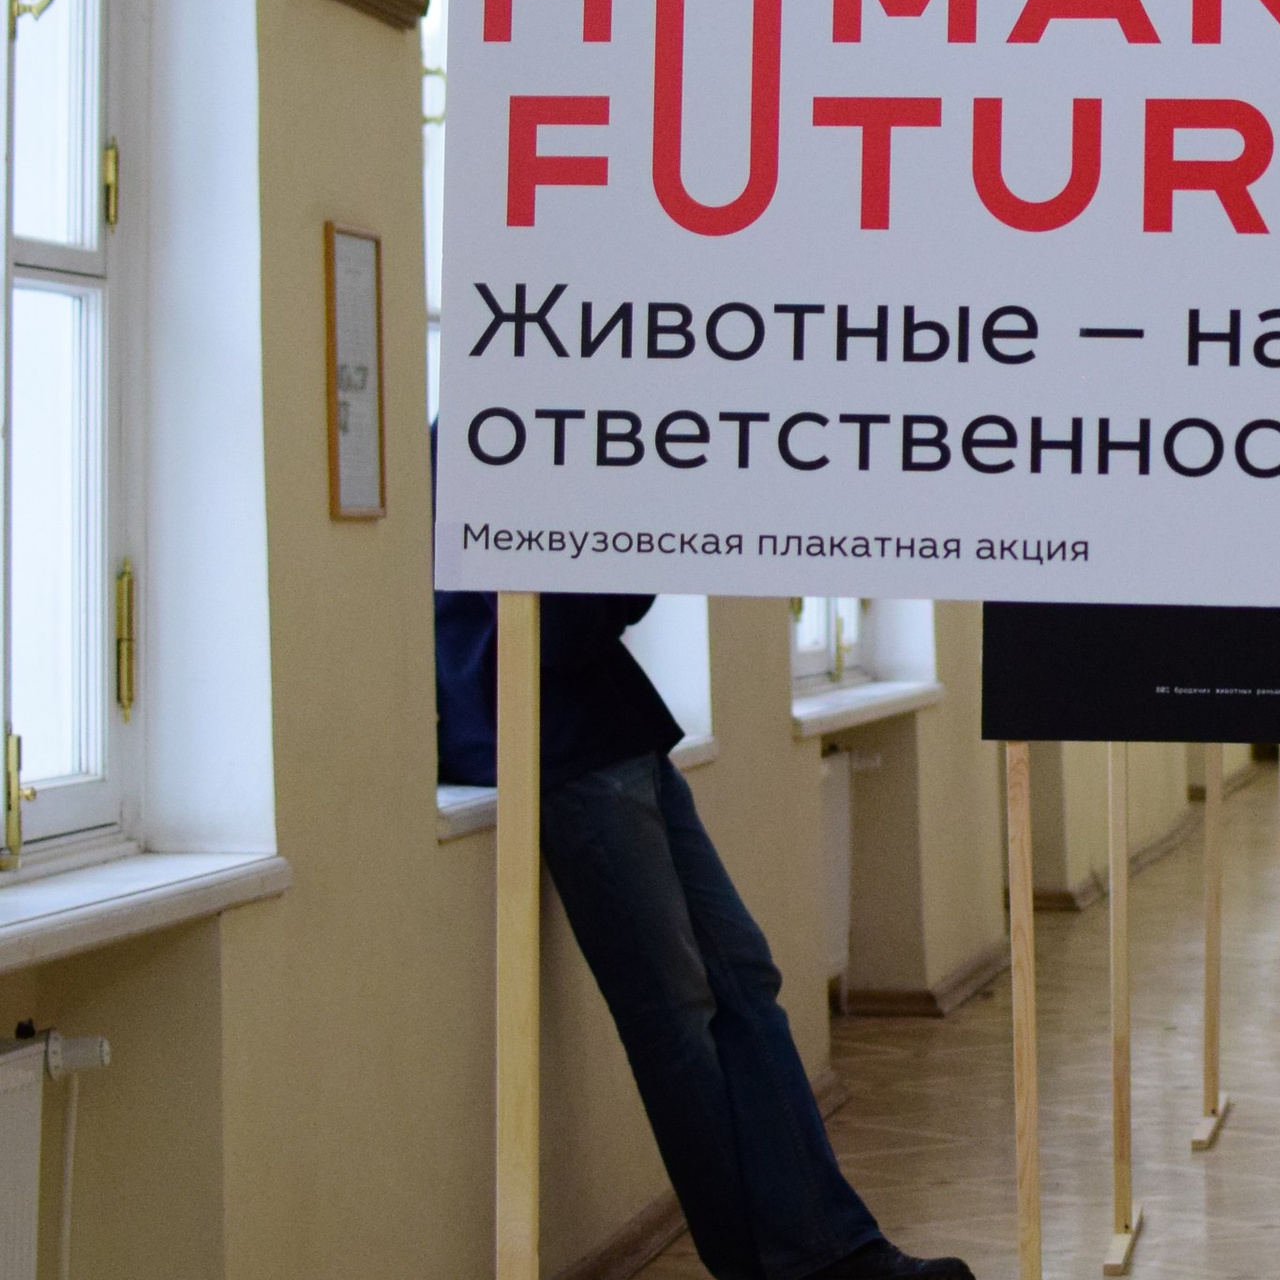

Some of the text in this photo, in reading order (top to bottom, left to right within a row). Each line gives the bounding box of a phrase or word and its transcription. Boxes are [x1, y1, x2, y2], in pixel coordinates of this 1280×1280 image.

[468, 282, 1039, 365] Животные
[463, 522, 744, 560] Межвузовская
[758, 534, 961, 560] плакатная
[975, 538, 1089, 566] акция
